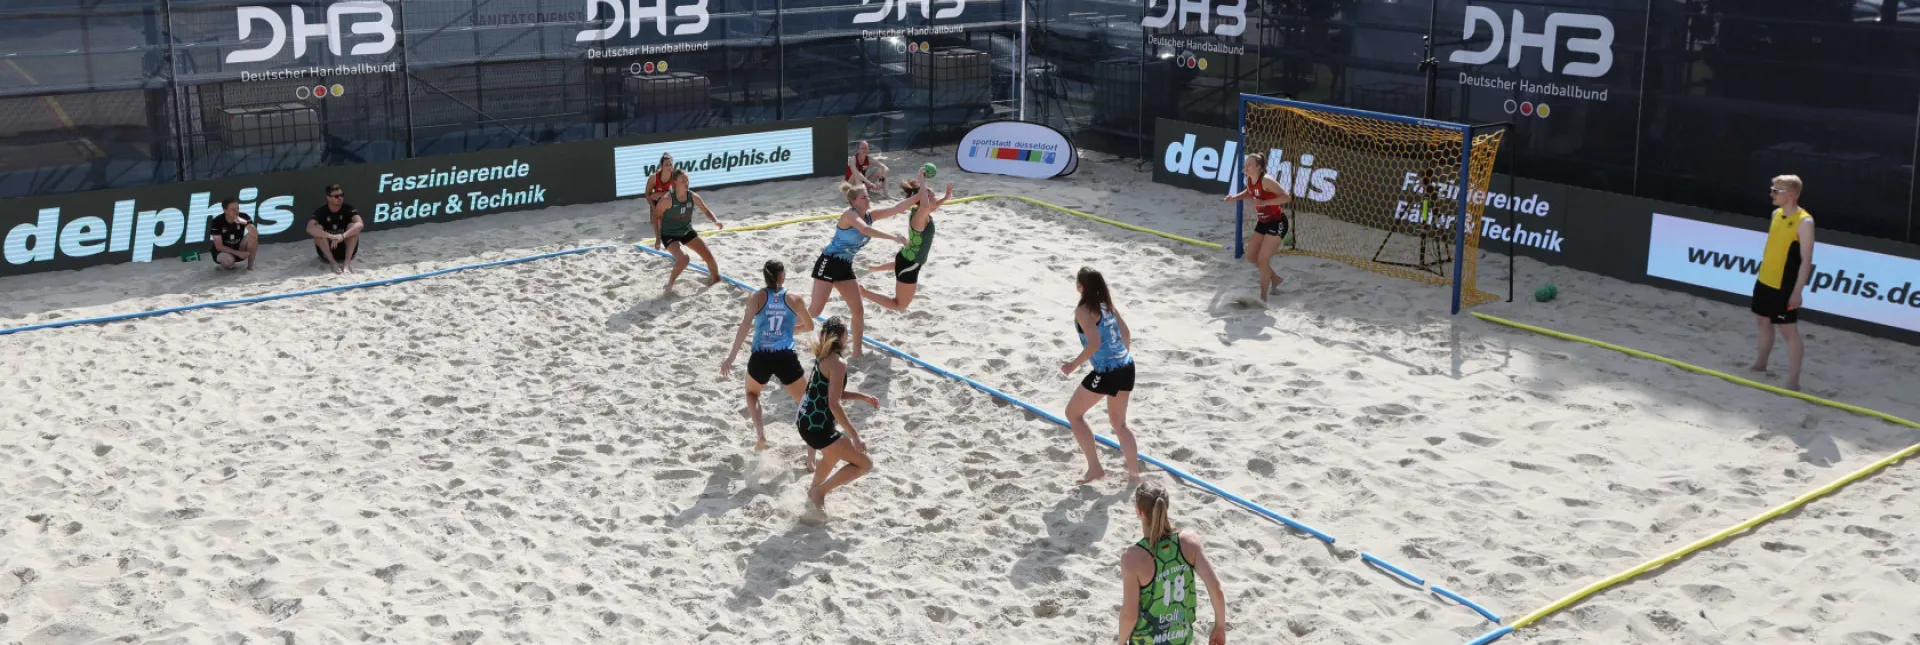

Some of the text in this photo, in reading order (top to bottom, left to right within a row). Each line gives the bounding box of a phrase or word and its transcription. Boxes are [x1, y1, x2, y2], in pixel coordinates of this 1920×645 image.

[225, 0, 396, 64] DHB
[575, 0, 710, 42] DHB
[862, 25, 964, 39] Deutscher Handballbund
[1141, 0, 1247, 37] DHB
[588, 41, 709, 59] Deutscher Handballbund
[1148, 34, 1244, 55] Deutscher Handballbund
[1448, 5, 1615, 78] DHB
[241, 62, 396, 82] Deutscher Handballbund
[1459, 72, 1608, 101] Deutscher Handballbund
[972, 139, 1012, 148] sportstadt
[378, 159, 530, 193] Faszinierende
[643, 146, 791, 178] ww.delphis.de
[373, 184, 547, 223] Bäder & Technik
[1402, 172, 1550, 217] Faziierende
[3, 187, 294, 265] delphis
[1481, 216, 1565, 252] Technik
[1688, 246, 1920, 308] wwwlphis.de
[768, 315, 784, 331] 17
[1163, 575, 1185, 607] 18
